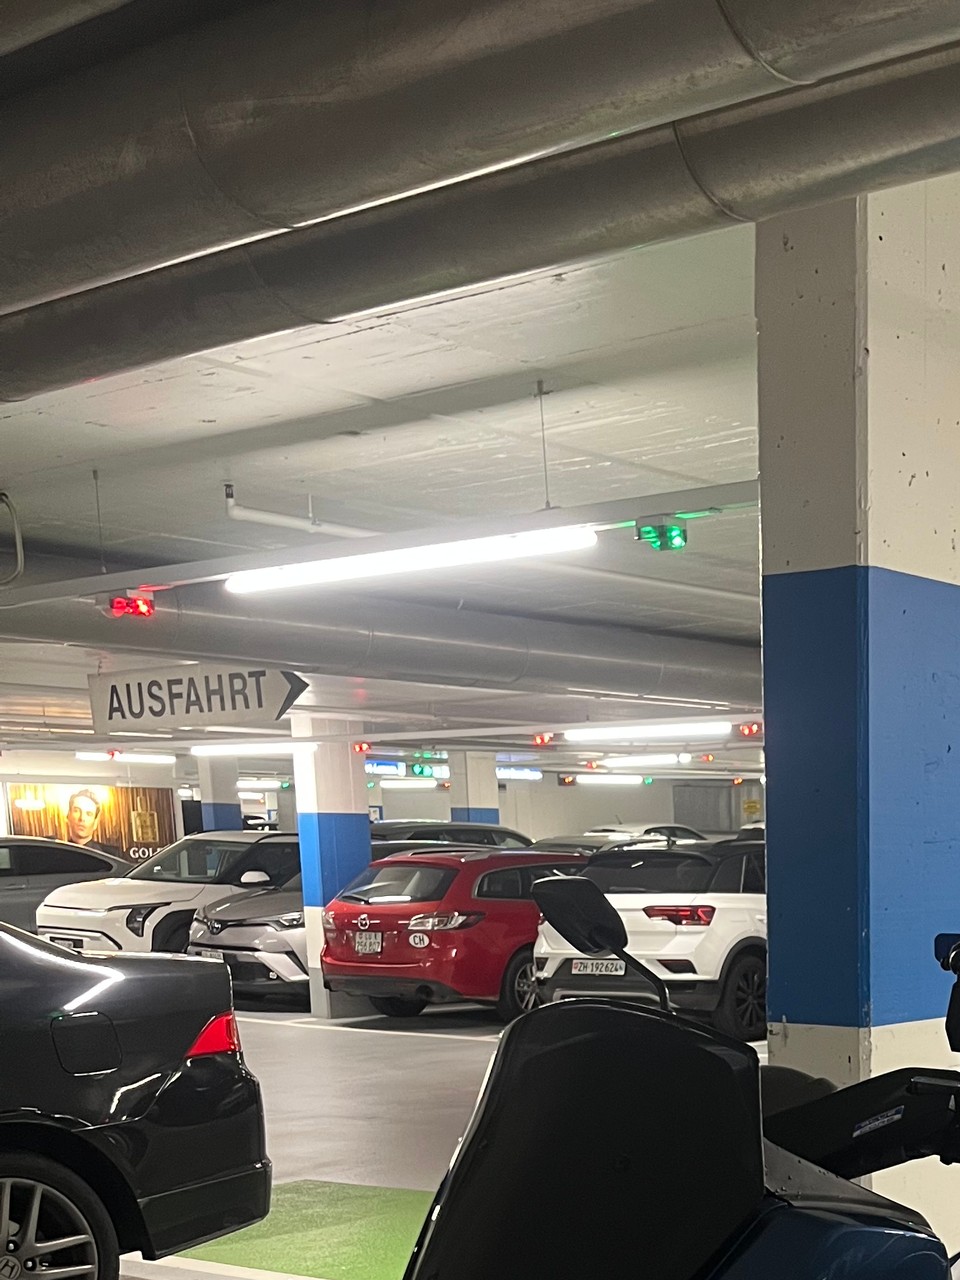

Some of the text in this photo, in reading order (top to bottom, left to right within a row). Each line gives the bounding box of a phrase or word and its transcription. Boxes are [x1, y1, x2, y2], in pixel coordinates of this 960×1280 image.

[108, 670, 267, 721] AUSFAHRT
[129, 847, 163, 859] GOL
[413, 935, 425, 946] CH
